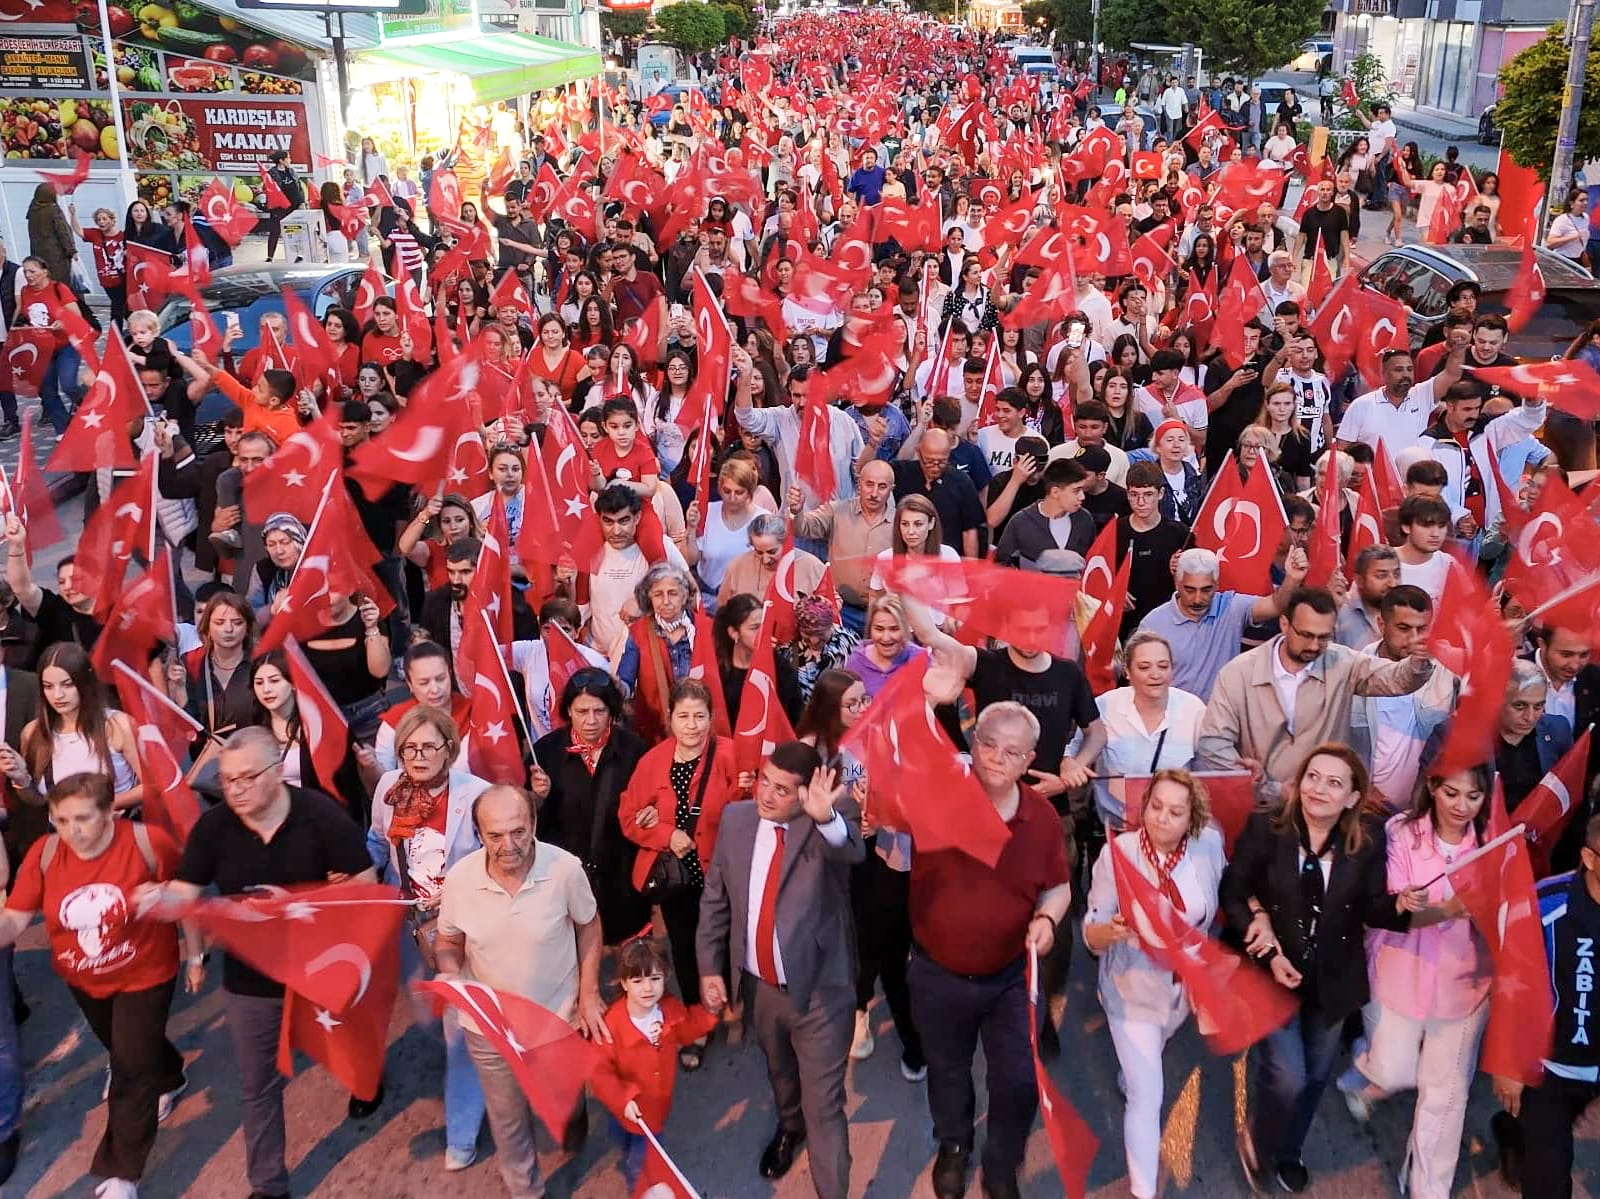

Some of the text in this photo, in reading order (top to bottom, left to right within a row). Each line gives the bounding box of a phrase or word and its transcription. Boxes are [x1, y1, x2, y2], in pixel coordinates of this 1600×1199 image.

[204, 108, 297, 130] KARDEŞLER
[213, 132, 292, 150] MANAV
[1297, 404, 1320, 414] beko
[1571, 937, 1595, 1045] ZABITA
